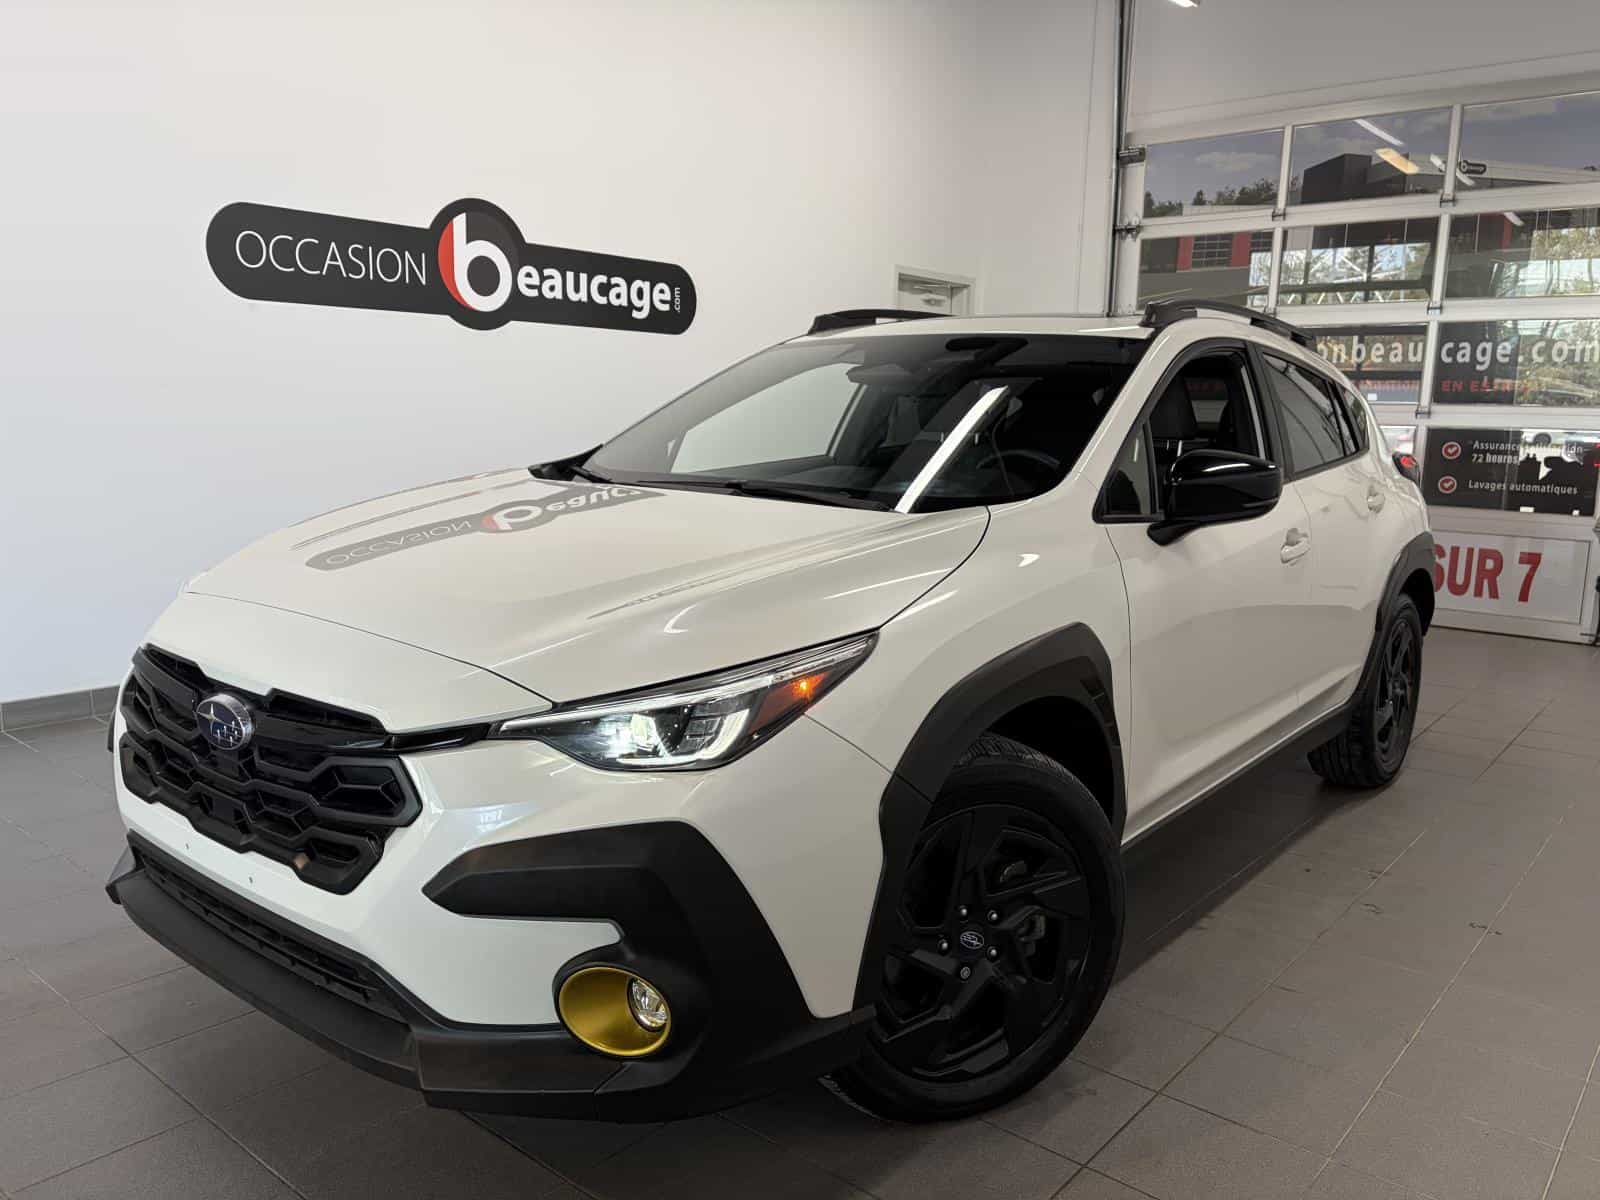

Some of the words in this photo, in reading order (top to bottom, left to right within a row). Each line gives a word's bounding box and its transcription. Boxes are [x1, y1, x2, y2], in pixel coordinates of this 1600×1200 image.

[235, 230, 427, 286] OCCASION
[452, 212, 671, 319] beaucage
[673, 287, 681, 313] .com
[1441, 380, 1464, 392] EN
[1472, 453, 1484, 463] 72
[1468, 480, 1506, 492] Lavages
[1509, 481, 1578, 496] automatiques
[1433, 543, 1504, 600] SUR
[1518, 551, 1543, 603] 7
